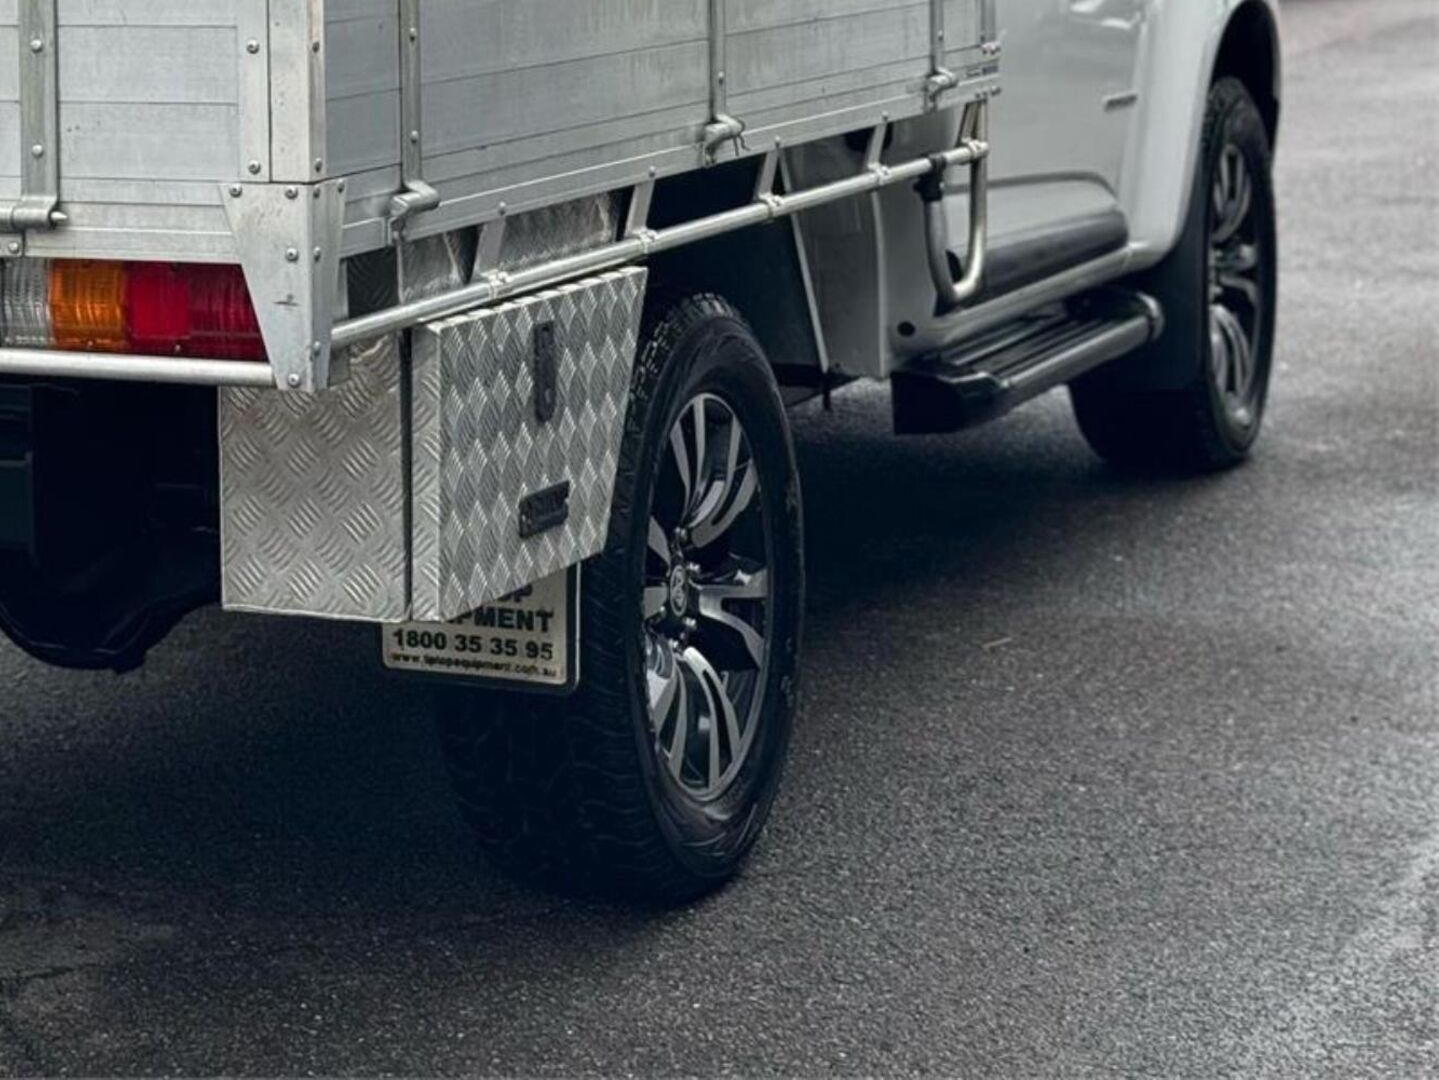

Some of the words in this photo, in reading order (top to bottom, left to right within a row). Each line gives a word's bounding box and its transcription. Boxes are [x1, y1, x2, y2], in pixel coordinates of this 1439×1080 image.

[393, 628, 447, 650] 1800
[454, 634, 482, 653] 35
[490, 637, 518, 657] 35
[525, 641, 554, 661] 95
